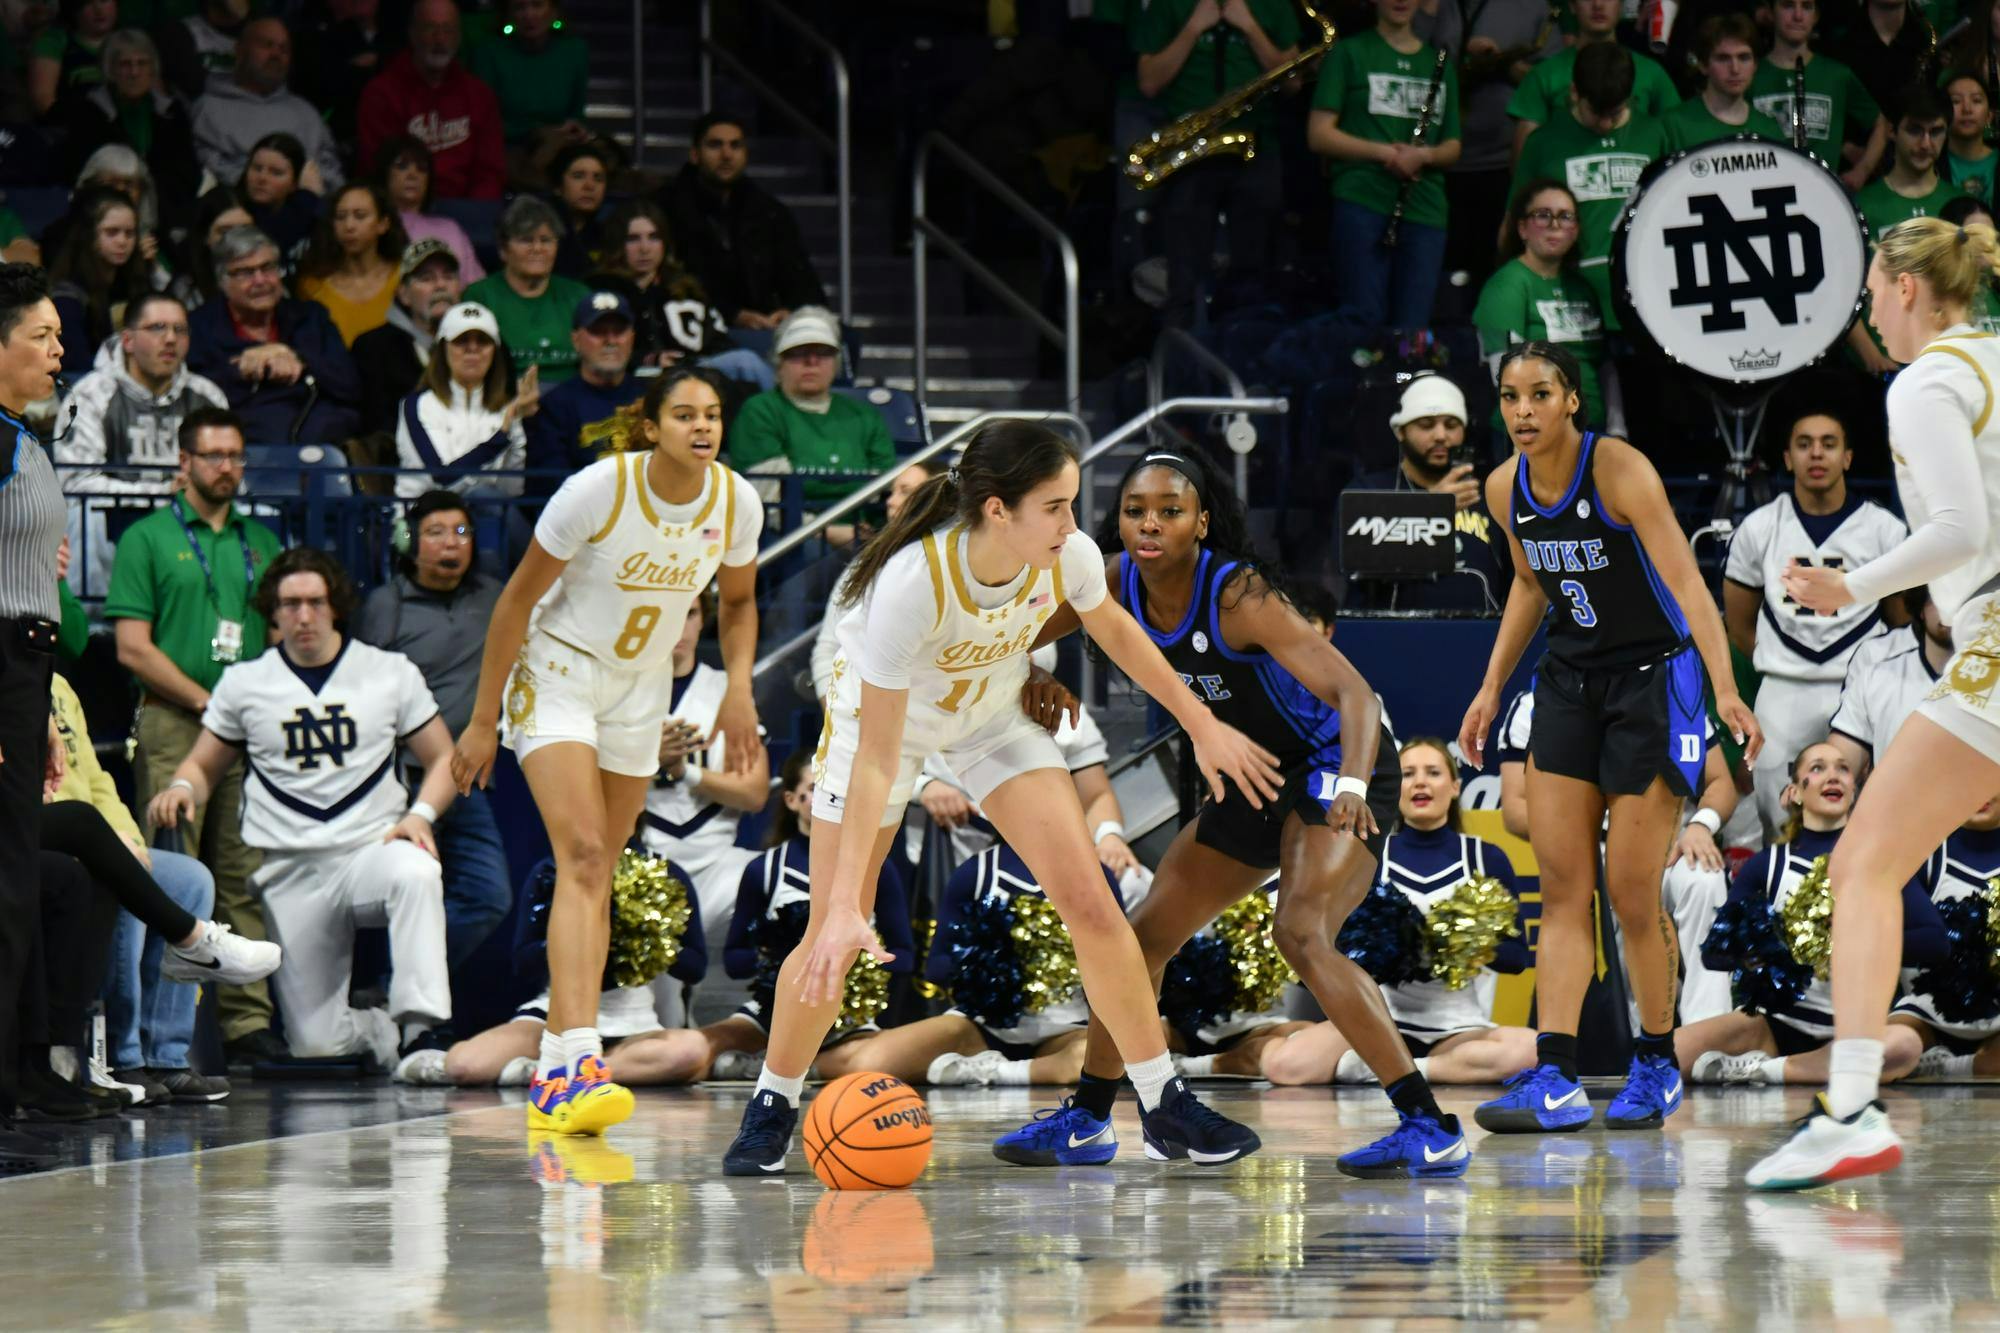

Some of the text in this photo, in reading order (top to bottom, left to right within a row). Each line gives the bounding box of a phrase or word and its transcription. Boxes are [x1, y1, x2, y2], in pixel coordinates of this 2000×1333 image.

[1711, 151, 1778, 175] YAMAHA
[1663, 185, 1826, 335] ND
[1347, 516, 1452, 546] MYSTRO
[616, 551, 701, 587] Irish
[1521, 538, 1609, 572] DUKE
[1560, 579, 1597, 627] 3
[613, 605, 662, 660] 8
[936, 624, 1032, 666] Irish
[281, 703, 358, 771] ND
[1679, 733, 1700, 763] D
[860, 1078, 904, 1099] CAA
